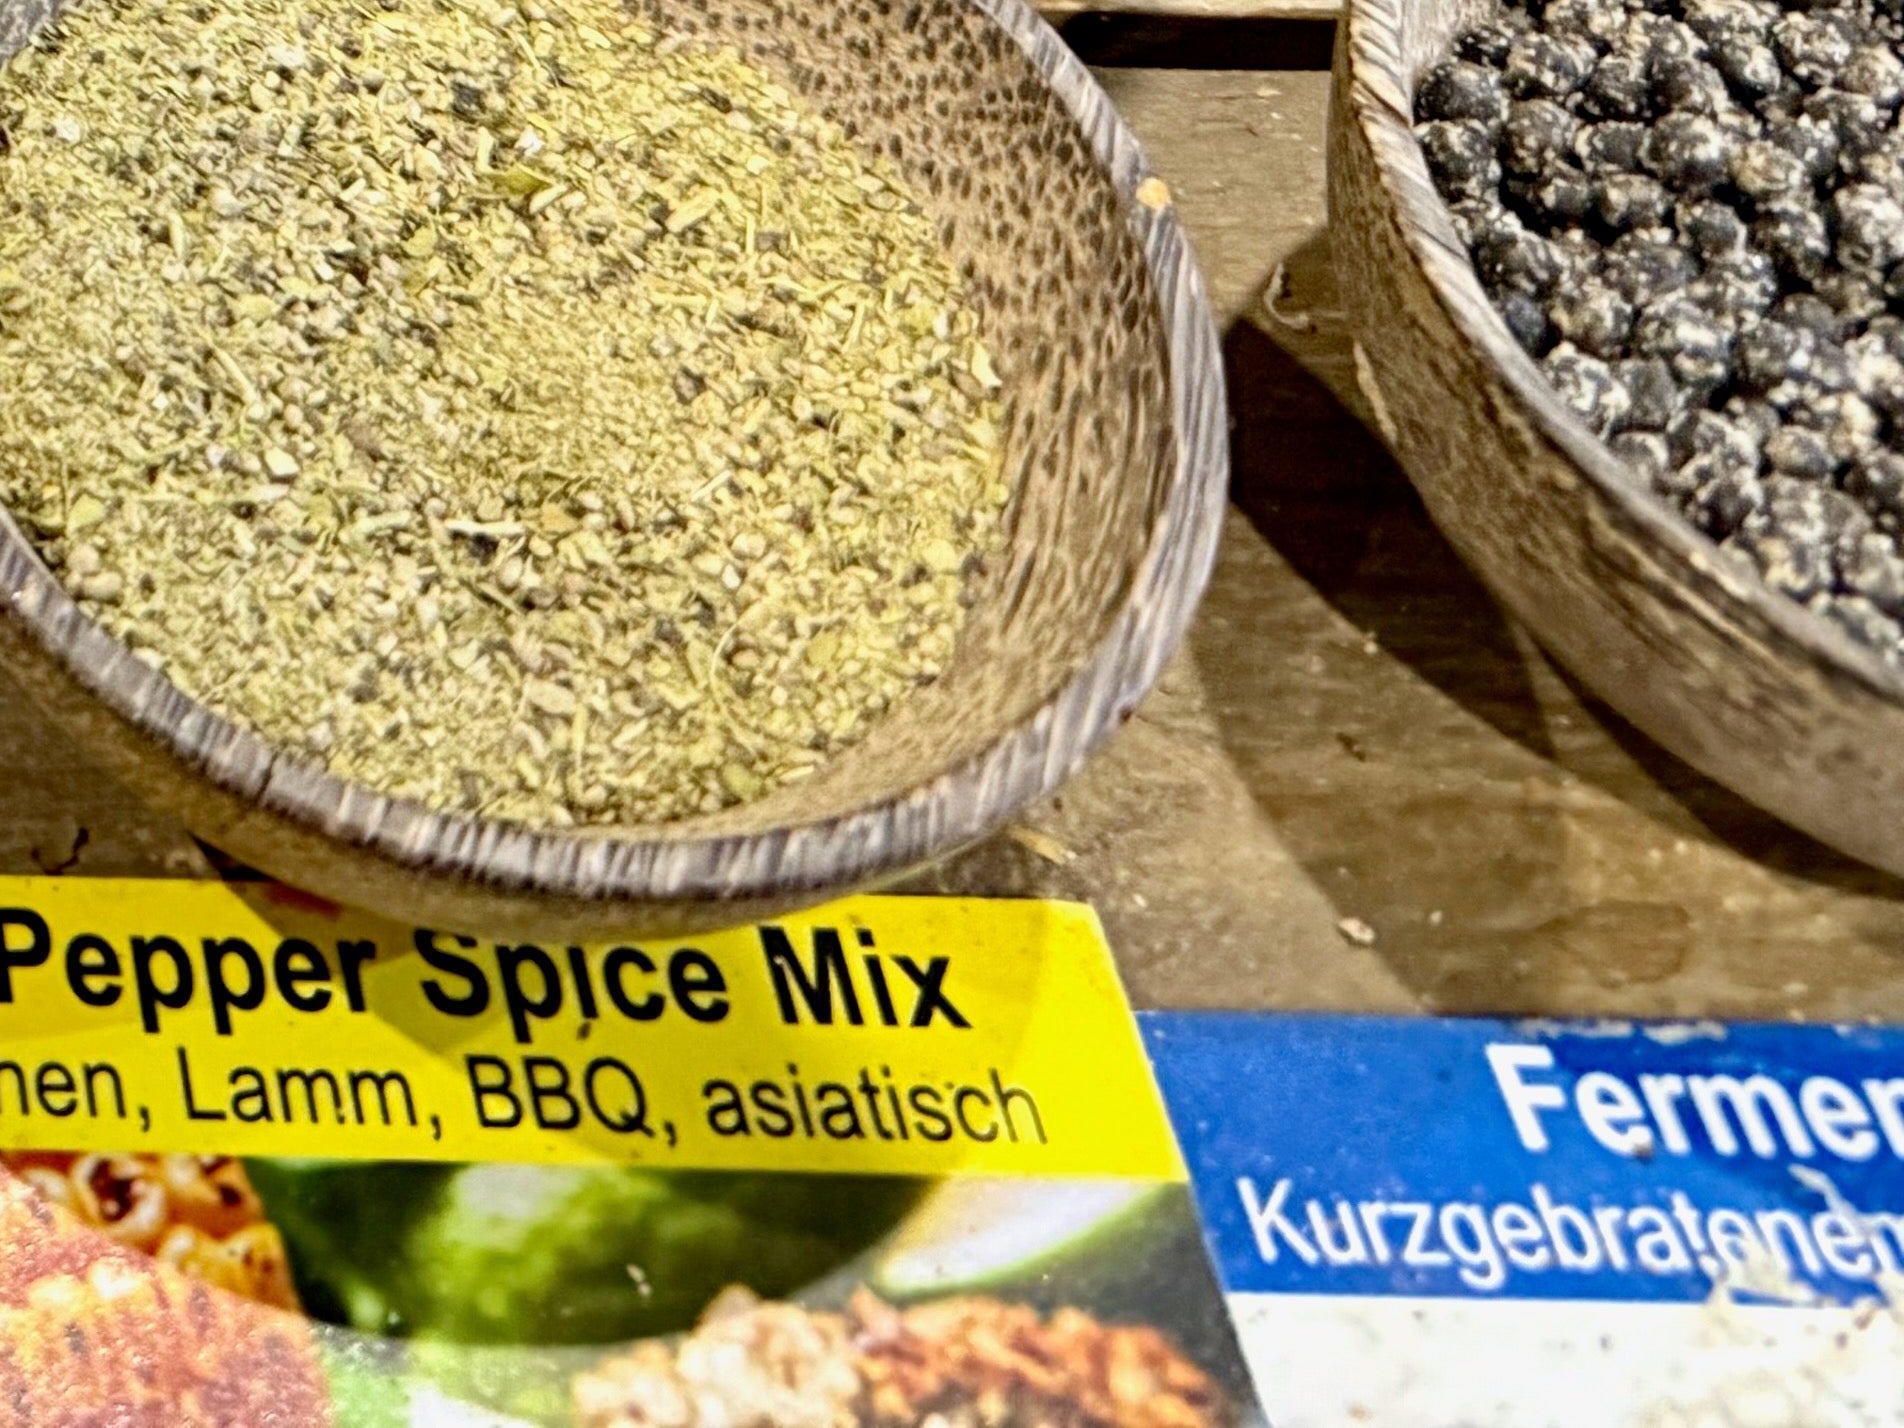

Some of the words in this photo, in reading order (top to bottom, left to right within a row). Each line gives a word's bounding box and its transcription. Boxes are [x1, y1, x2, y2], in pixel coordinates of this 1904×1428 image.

[419, 927, 730, 1046] Spice
[760, 926, 973, 1031] Mix
[177, 1045, 443, 1142] Lamm,
[465, 1054, 680, 1148] BBQ,
[703, 1064, 1049, 1146] asiatisch
